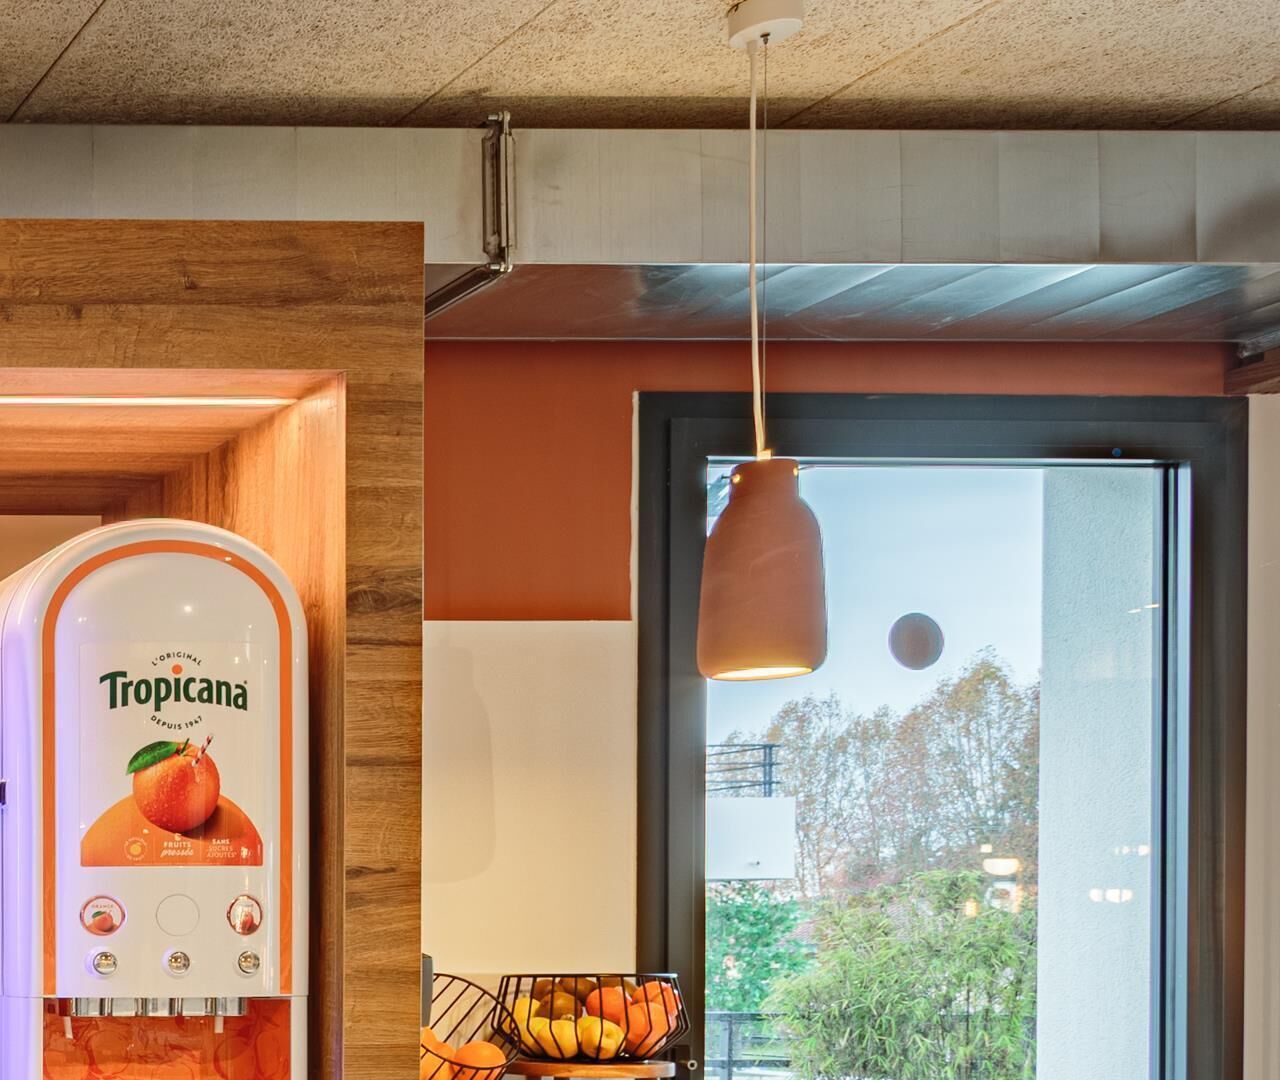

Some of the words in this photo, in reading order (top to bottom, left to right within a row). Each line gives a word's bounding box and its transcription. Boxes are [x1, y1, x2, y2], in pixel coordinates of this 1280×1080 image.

[151, 651, 202, 666] L'ORIGINAL
[99, 664, 248, 713] Tropicana
[150, 714, 183, 730] DEPUIS
[184, 715, 203, 729] 1947
